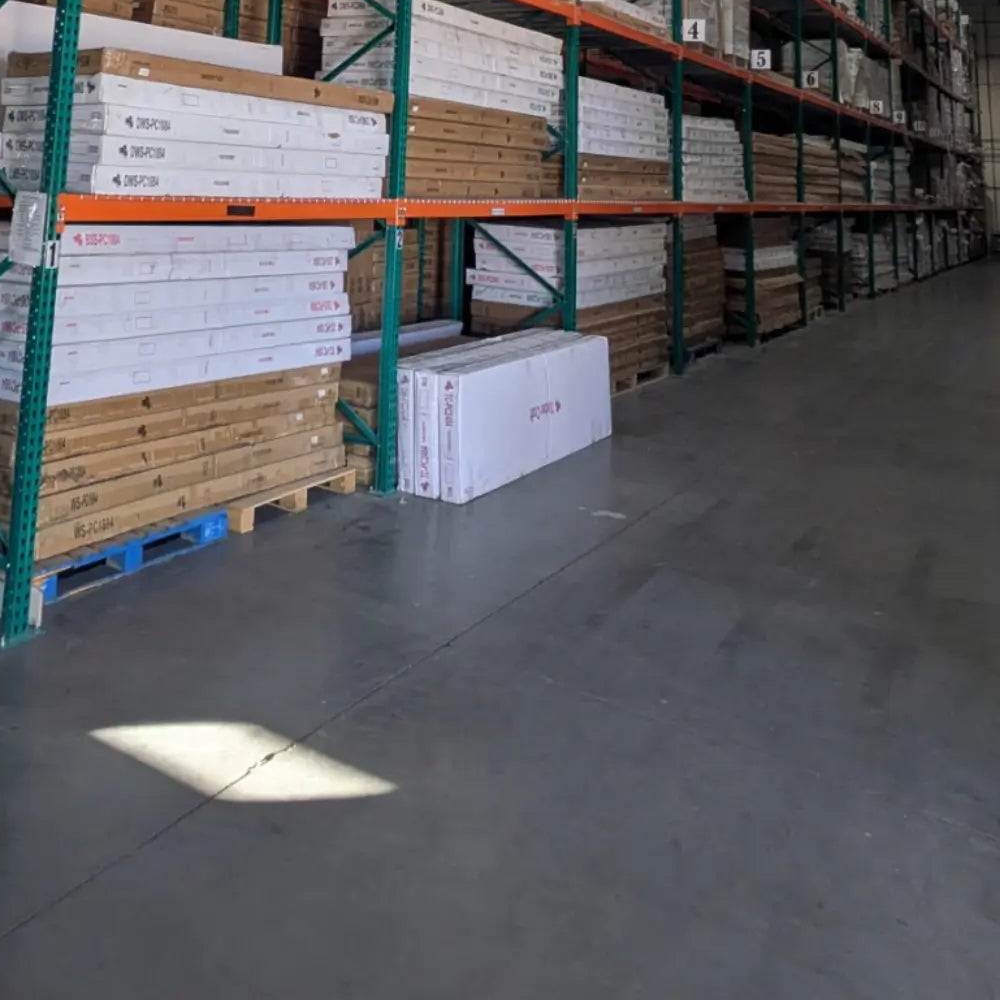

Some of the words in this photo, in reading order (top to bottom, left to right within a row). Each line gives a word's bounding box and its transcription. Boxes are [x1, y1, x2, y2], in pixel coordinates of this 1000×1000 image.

[688, 21, 699, 39] 4
[756, 52, 766, 67] 5
[806, 72, 815, 86] 6
[872, 102, 881, 113] 8
[50, 242, 56, 267] 1
